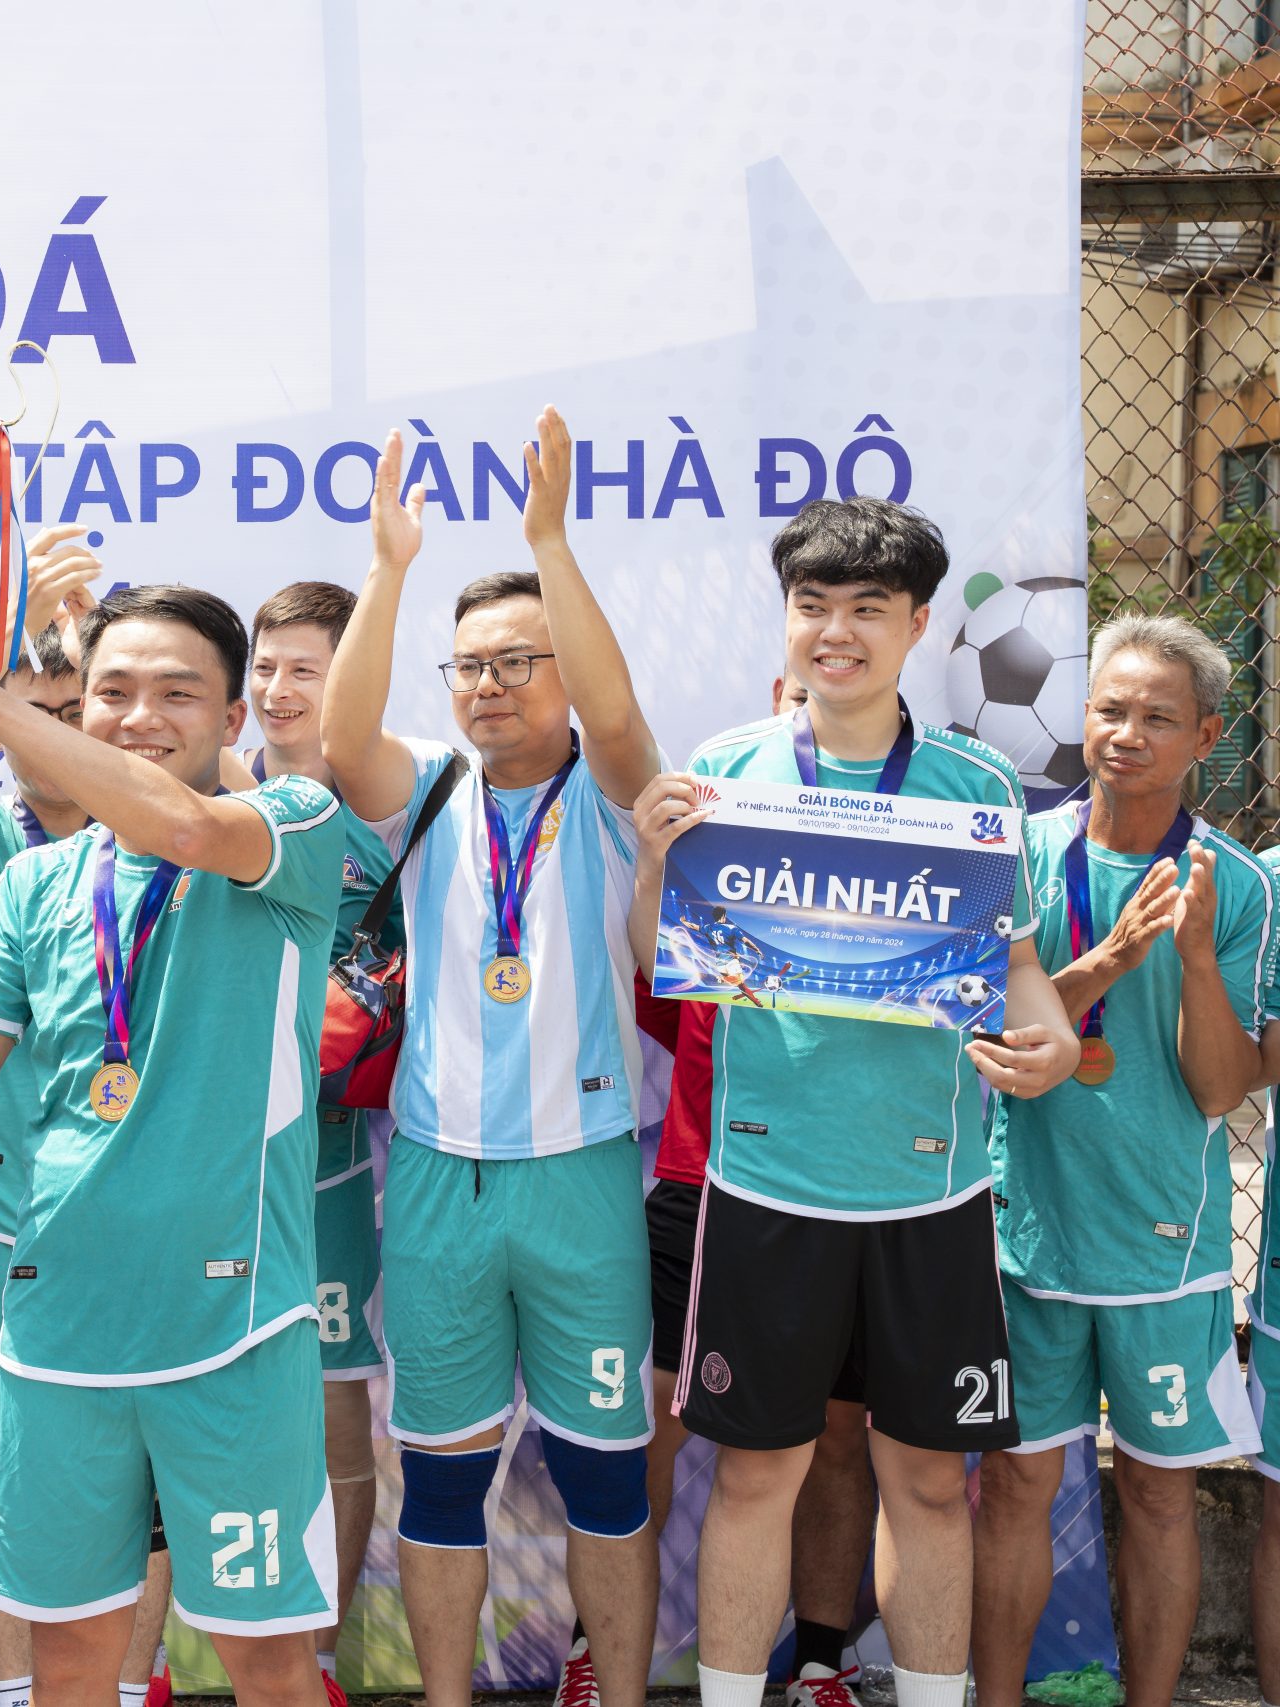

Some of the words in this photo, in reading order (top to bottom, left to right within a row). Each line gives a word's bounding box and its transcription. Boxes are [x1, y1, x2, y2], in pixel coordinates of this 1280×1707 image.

[10, 420, 202, 548] TẬP
[231, 418, 530, 524] ĐOÀN
[575, 415, 726, 520] HÀ
[754, 413, 914, 519] ĐÔ
[749, 802, 771, 812] NIỆM
[772, 805, 784, 814] 34
[785, 806, 805, 815] NĂM
[806, 808, 830, 818] NGÀY
[832, 811, 862, 821] THÀNH
[863, 814, 880, 824] LẬP
[882, 816, 898, 826] TẬP
[899, 817, 924, 828] ĐOÀN
[925, 820, 939, 830] HÀ
[940, 821, 954, 831] ĐÔ
[798, 792, 827, 807] GIẢI
[829, 795, 871, 811] BÓNG
[873, 799, 894, 814] ĐÁ
[798, 818, 840, 830] 09/10/1990
[847, 823, 890, 835] 09/10/2024
[970, 811, 1005, 841] 34
[716, 857, 816, 908] GIẢI
[825, 867, 961, 923] NHẤT
[770, 925, 782, 934] Hà
[800, 930, 819, 939] ngày
[820, 931, 830, 939] 28
[831, 932, 853, 943] tháng
[884, 938, 904, 947] 2024
[316, 1282, 351, 1343] 8
[589, 1347, 625, 1410] 9
[954, 1357, 1010, 1424] 21
[1147, 1363, 1189, 1427] 3
[211, 1509, 281, 1589] 21
